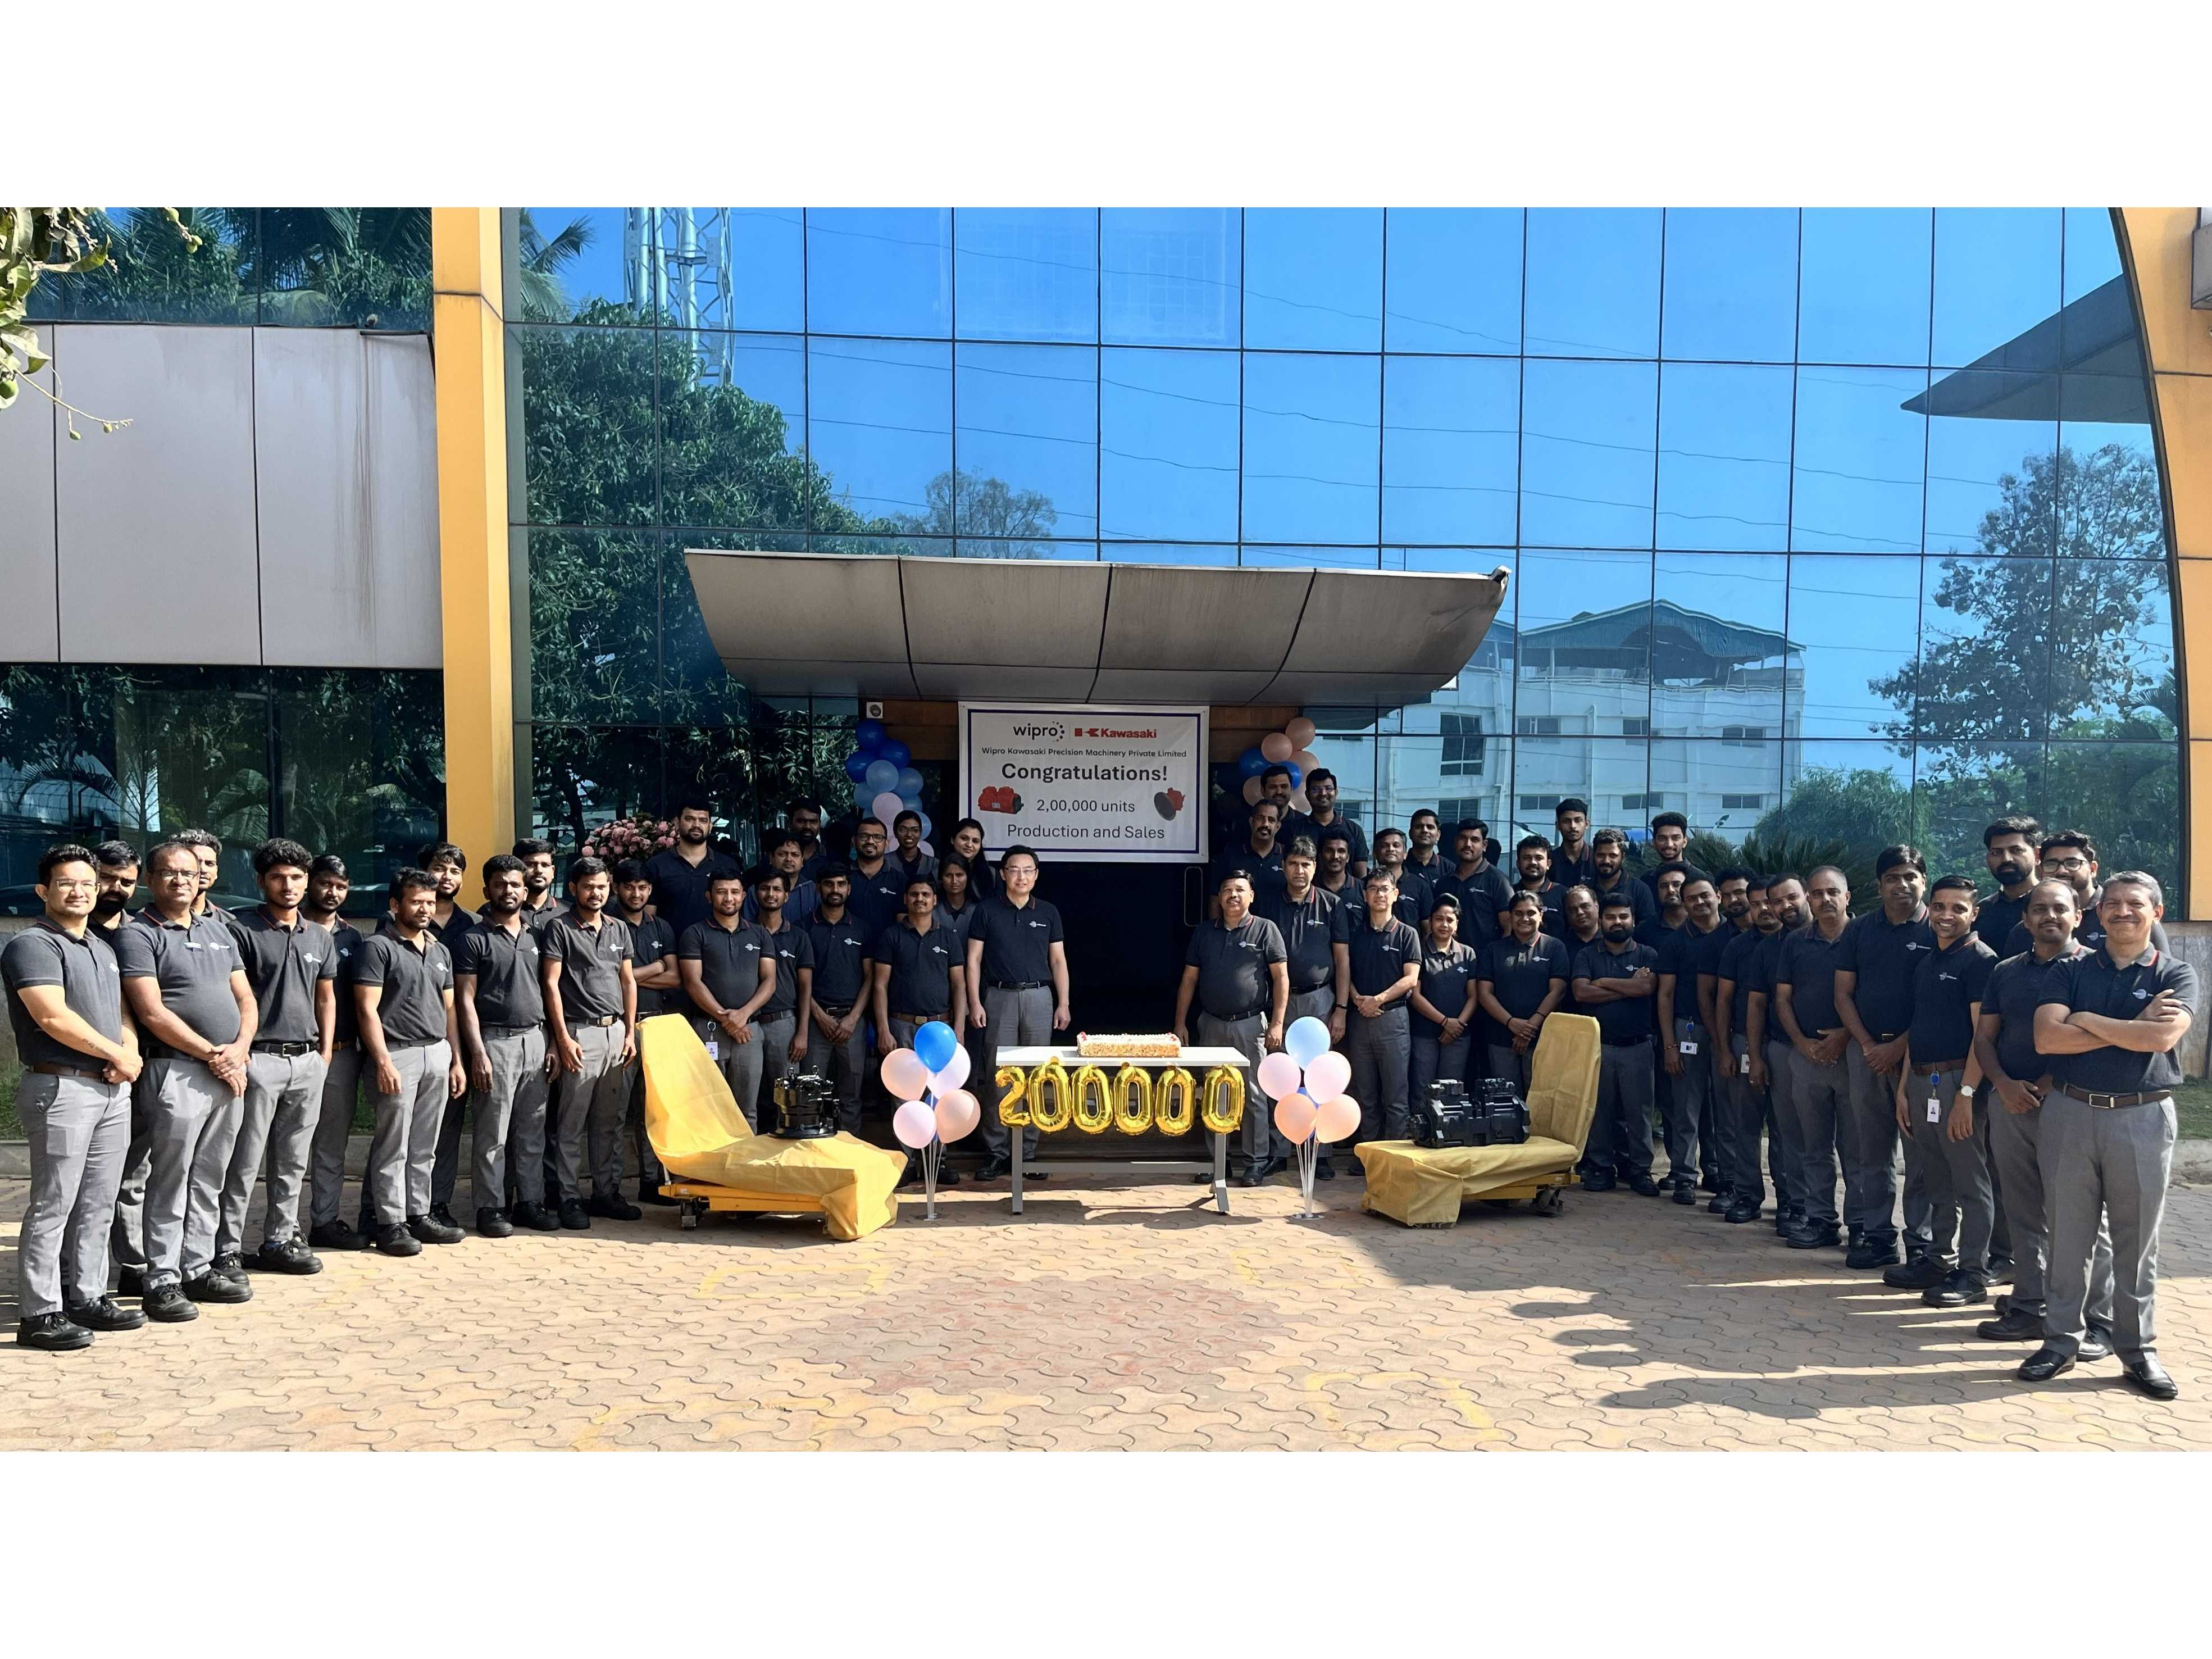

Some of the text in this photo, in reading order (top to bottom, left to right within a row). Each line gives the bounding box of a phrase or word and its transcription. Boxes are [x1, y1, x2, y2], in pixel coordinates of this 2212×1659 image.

[1013, 722, 1157, 740] wipro Kawasaki
[982, 747, 1005, 756] Wipro
[1002, 763, 1168, 783] Congratulations!
[1036, 799, 1135, 813] 2,00,000 units
[1008, 824, 1165, 839] Production and Sales
[995, 1060, 1245, 1135] 200000
